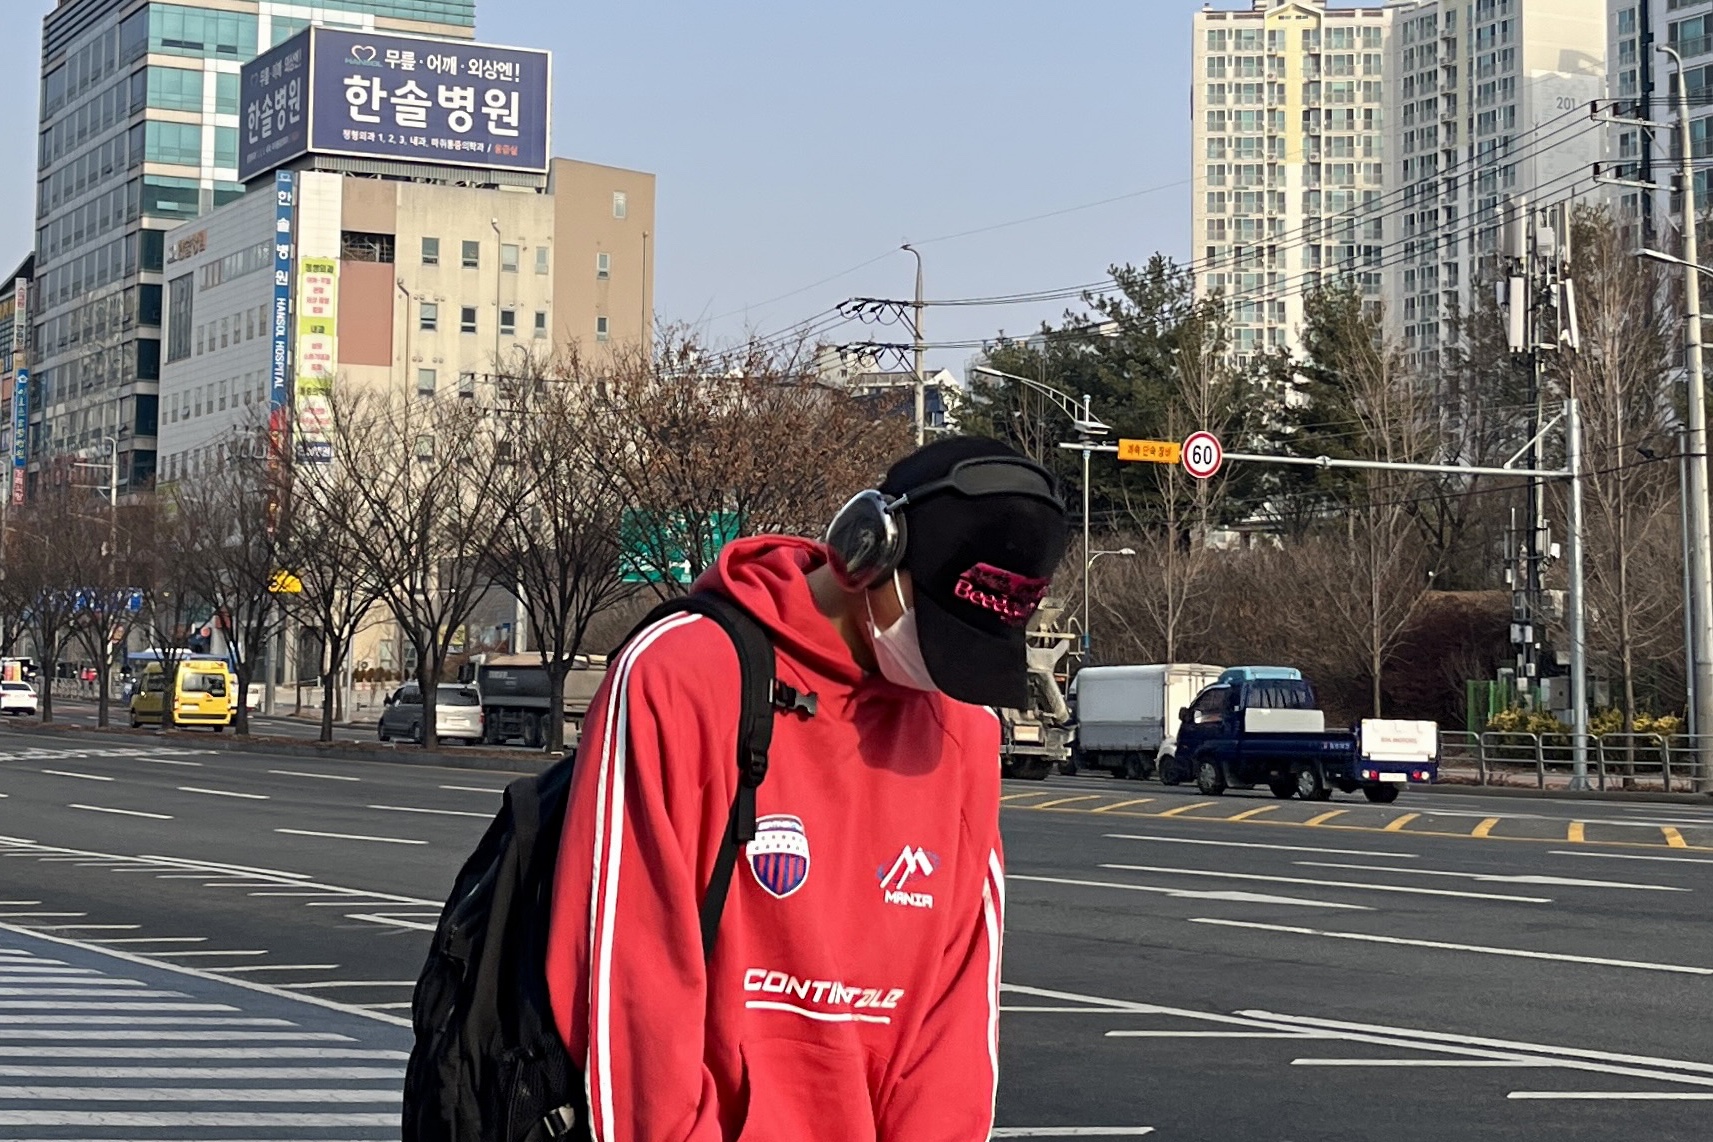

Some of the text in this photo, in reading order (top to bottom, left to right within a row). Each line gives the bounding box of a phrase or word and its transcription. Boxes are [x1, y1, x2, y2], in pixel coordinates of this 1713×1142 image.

[384, 49, 520, 83] 무릎 어깨 외상엔!
[247, 77, 301, 145] 한솔병원
[343, 74, 520, 137] 한솔병원
[1556, 96, 1576, 110] 201
[275, 190, 292, 286] 한솔병원
[273, 297, 287, 389] HANSOL HOSPITAL
[1192, 445, 1212, 465] 60
[884, 889, 934, 909] MANIA
